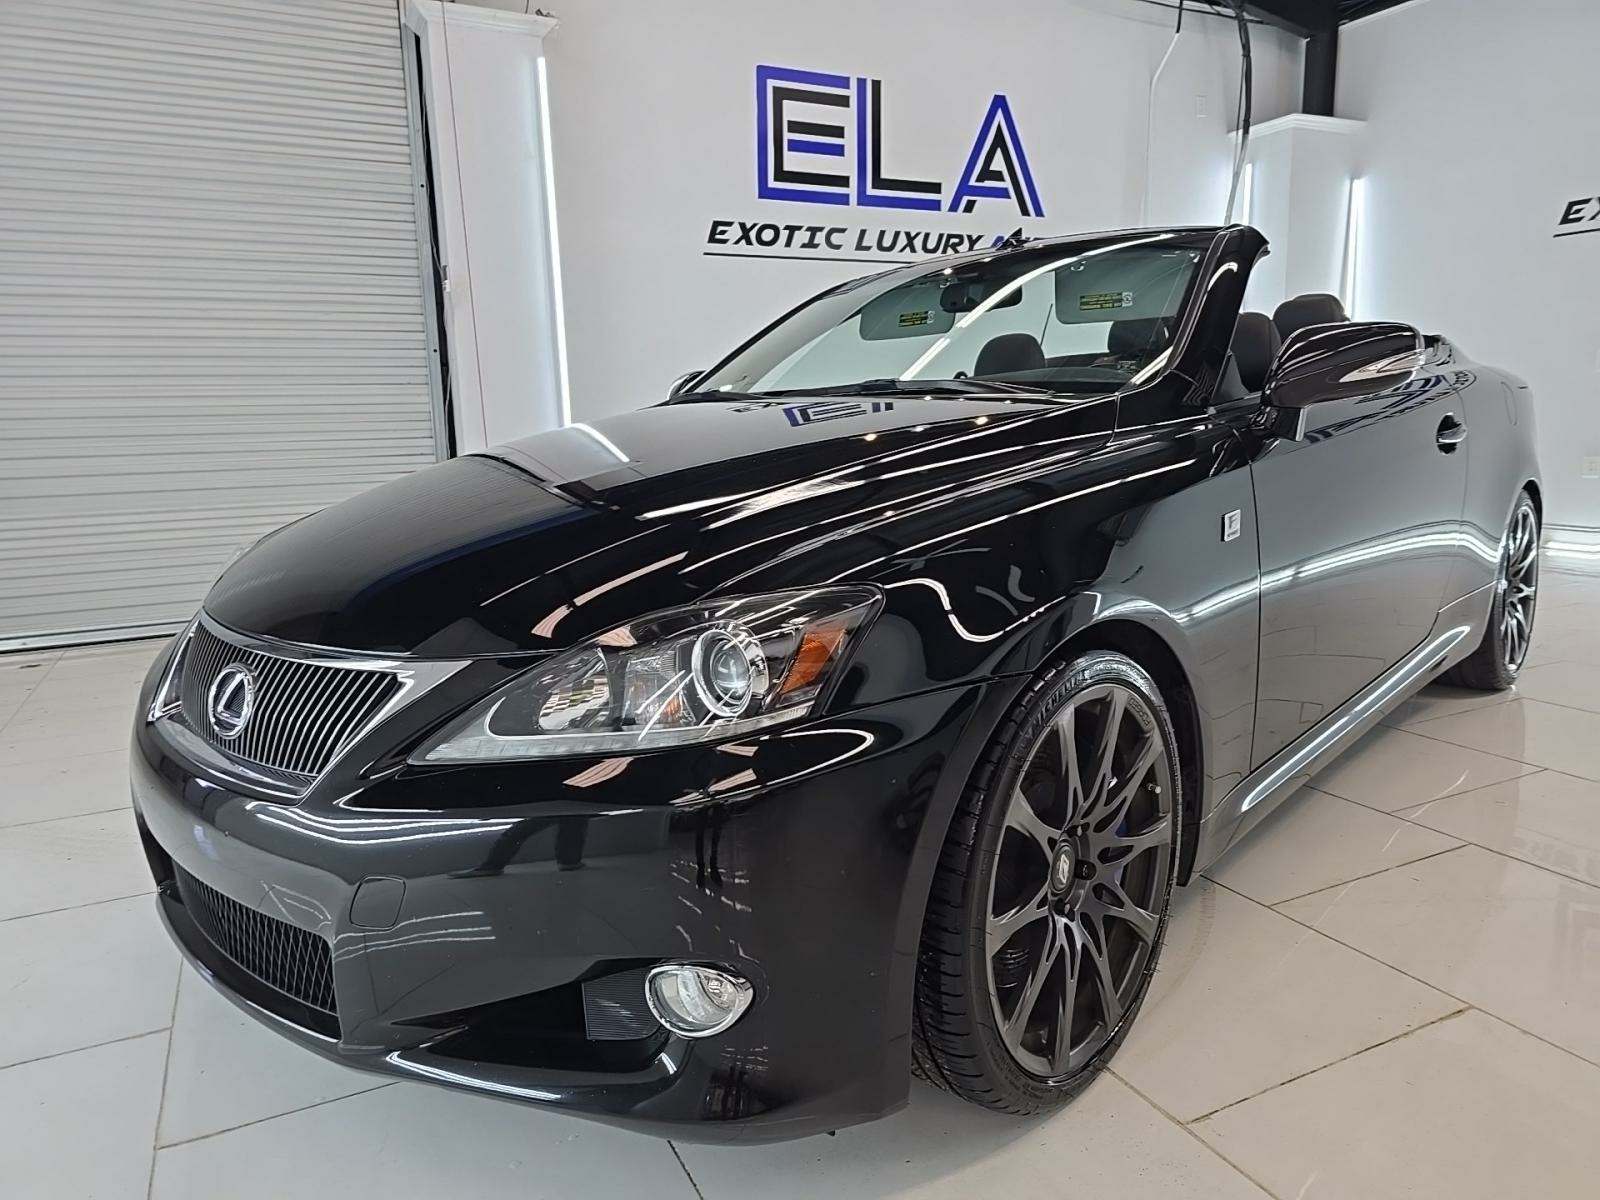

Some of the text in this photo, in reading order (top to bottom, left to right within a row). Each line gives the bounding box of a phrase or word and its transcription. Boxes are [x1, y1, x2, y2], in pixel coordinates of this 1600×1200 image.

[756, 64, 1045, 218] ELA
[707, 220, 848, 250] EXOTIC
[854, 228, 984, 254] LUXURY
